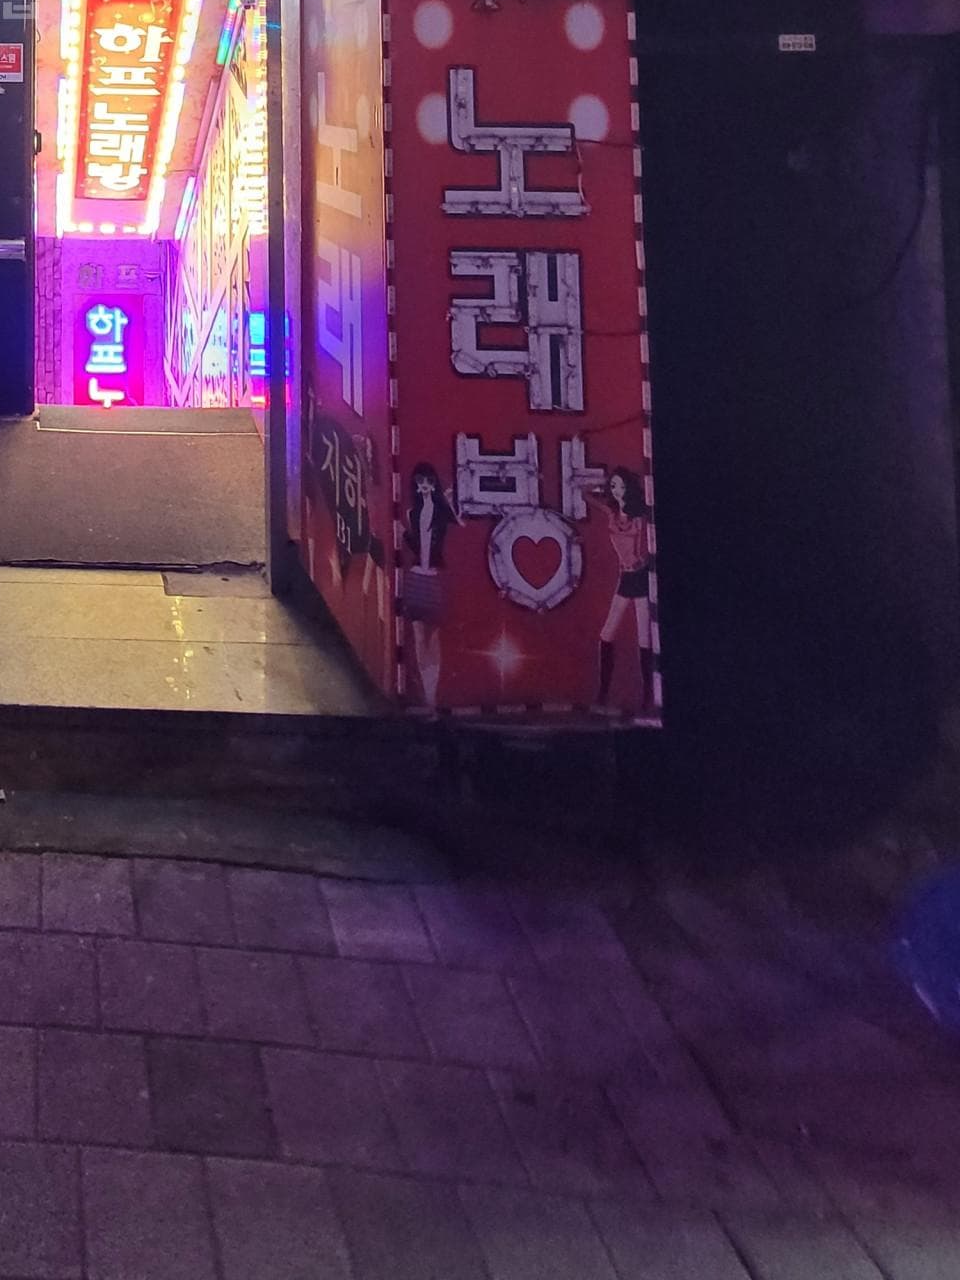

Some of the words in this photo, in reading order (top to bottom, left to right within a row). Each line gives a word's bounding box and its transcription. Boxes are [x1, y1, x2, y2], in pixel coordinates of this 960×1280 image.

[442, 68, 606, 611] 노래방
[321, 431, 367, 536] 지하
[336, 511, 353, 555] B1
